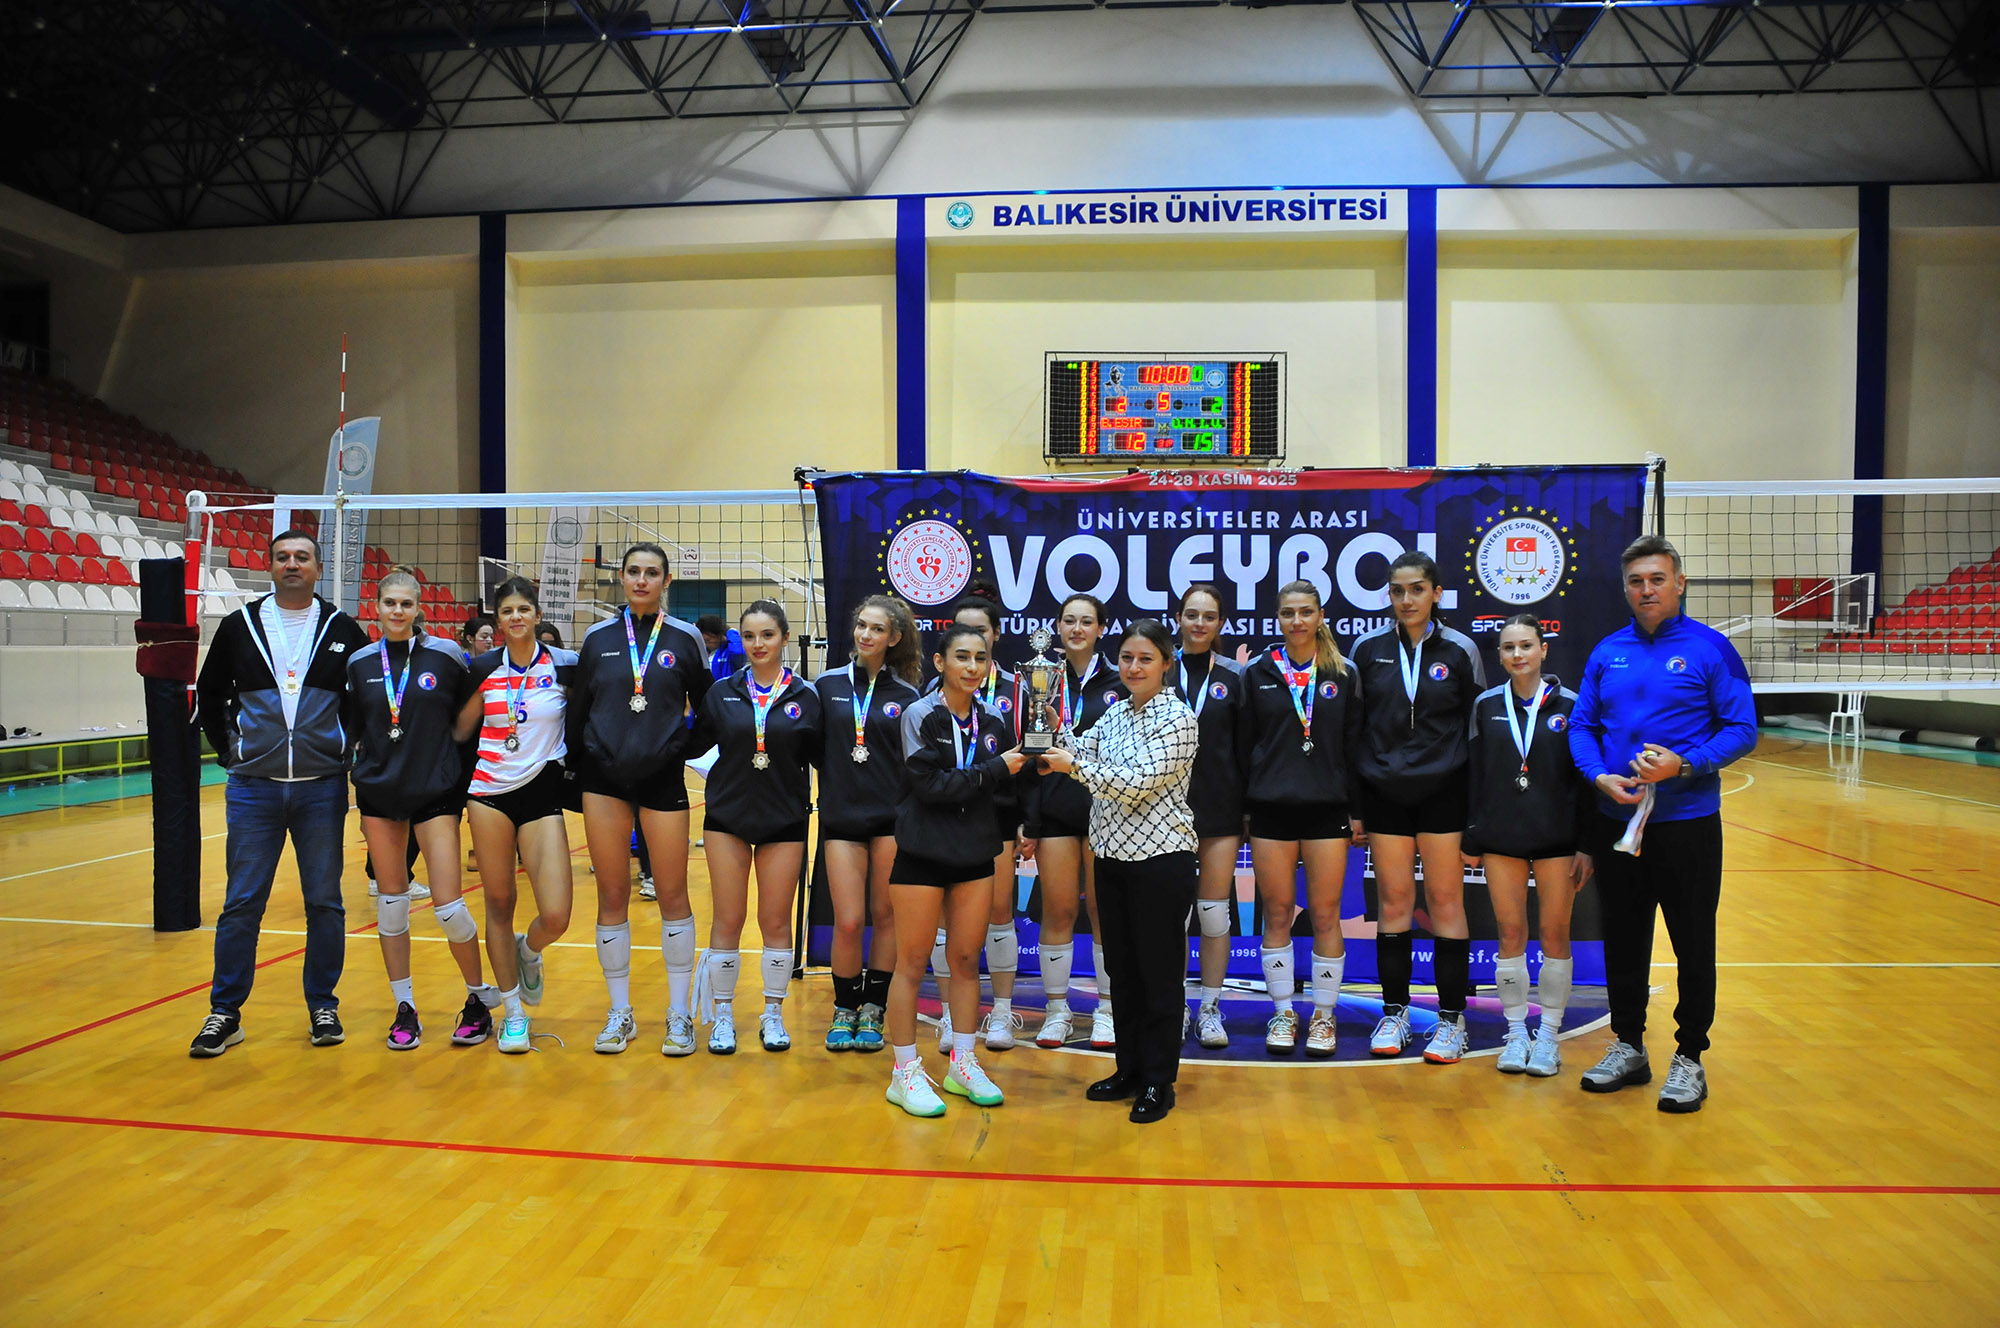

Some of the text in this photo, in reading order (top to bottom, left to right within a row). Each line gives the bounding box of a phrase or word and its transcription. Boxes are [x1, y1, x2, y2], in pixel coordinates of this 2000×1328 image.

[993, 194, 1159, 227] BALIKESİR
[1165, 192, 1388, 224] ÜNİVERSİTESİ
[1144, 365, 1191, 385] 10:00
[1117, 396, 1127, 413] 2
[1158, 392, 1170, 412] 5
[1211, 396, 1223, 413] 2
[1126, 432, 1147, 452] 12
[1193, 432, 1213, 452] 15
[1148, 473, 1194, 487] 24-28
[1257, 473, 1298, 487] 2025
[1077, 506, 1369, 530] ÜNİVERSİTELER ARASI
[1480, 522, 1561, 593] TÜRKİYE ÜNİVERSİTE SPORLARI FEDERASYONU
[987, 533, 1458, 612] VOLEYBOL
[1510, 592, 1531, 600] 1996
